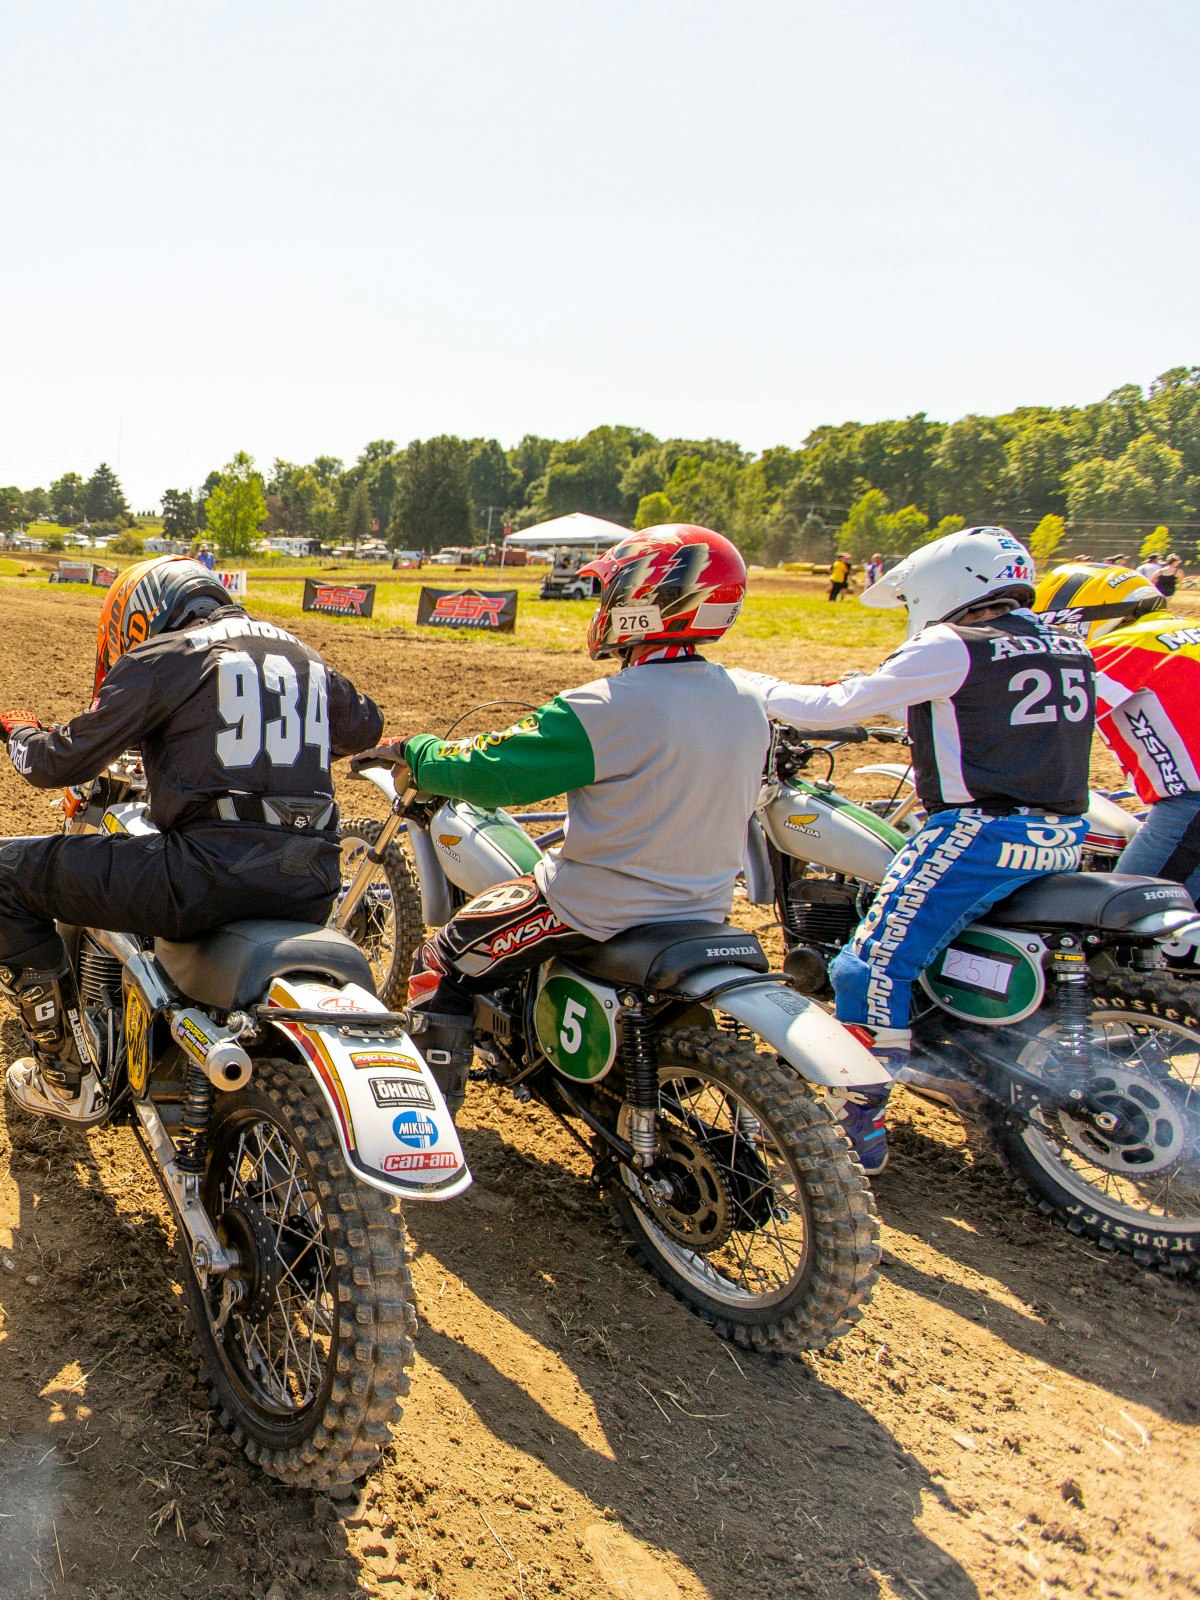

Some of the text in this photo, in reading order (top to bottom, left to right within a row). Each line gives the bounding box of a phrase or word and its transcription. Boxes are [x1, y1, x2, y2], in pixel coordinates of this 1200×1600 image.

[313, 587, 367, 615] SSR
[432, 595, 506, 626] SSR
[620, 614, 649, 630] 276
[1008, 668, 1097, 726] 25
[215, 650, 331, 772] 934
[784, 821, 820, 838] HONDA
[435, 838, 461, 862] HONDA
[1143, 890, 1188, 901] HONDA
[491, 913, 562, 954] ANSW
[706, 945, 758, 957] HONDA
[945, 950, 1002, 990] 251
[559, 997, 587, 1054] 5
[376, 1080, 429, 1101] ÖHLINS
[398, 1122, 434, 1135] MIKUNI
[385, 1153, 455, 1170] can-am
